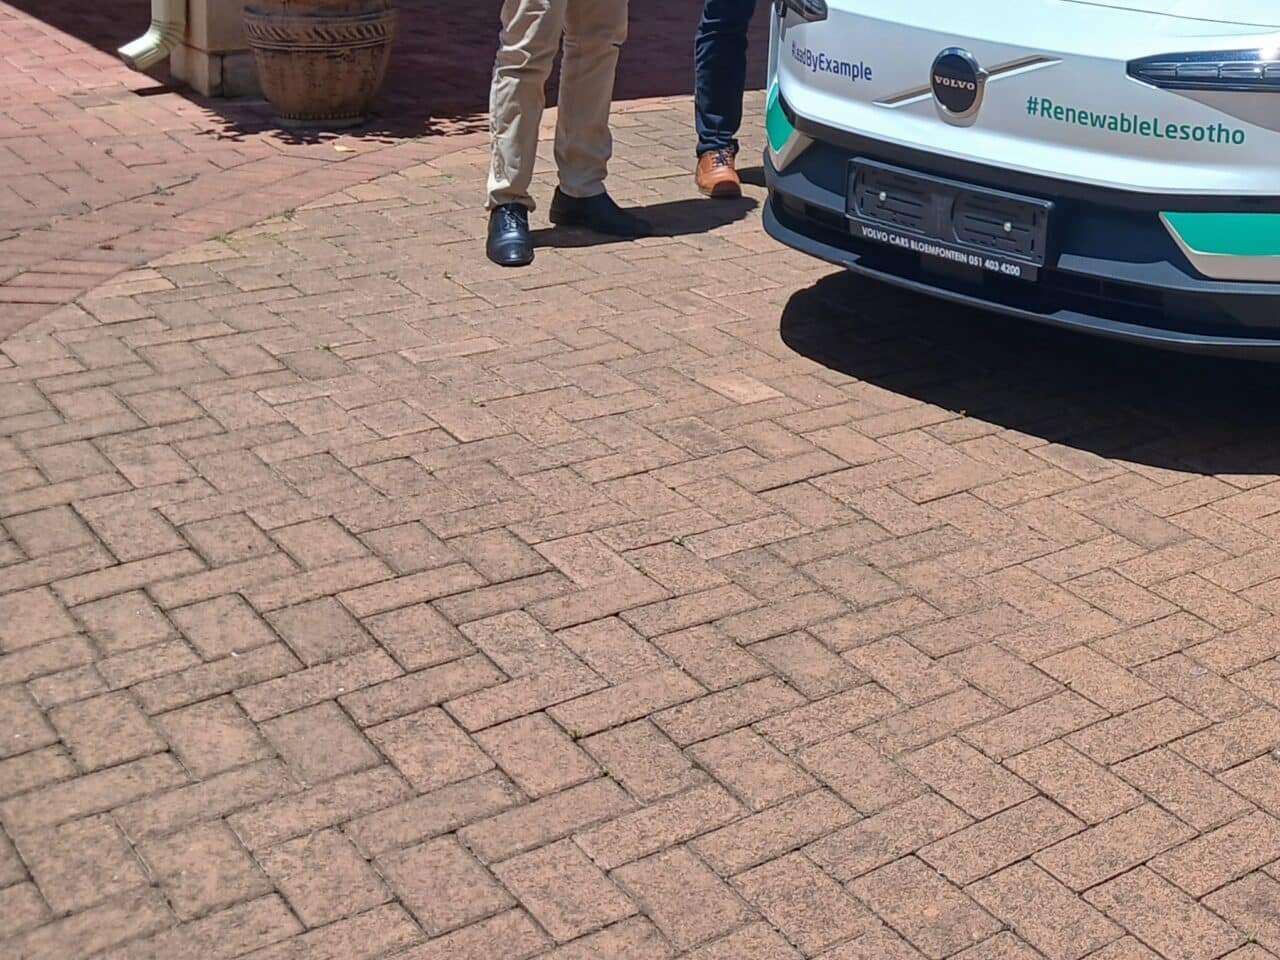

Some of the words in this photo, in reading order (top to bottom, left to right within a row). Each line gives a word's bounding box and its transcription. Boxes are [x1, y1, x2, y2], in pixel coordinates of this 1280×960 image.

[791, 40, 873, 82] #LeadByExample
[934, 74, 976, 91] VOLVO
[1026, 95, 1246, 145] #RenewableLesotho
[861, 226, 888, 242] VOLVO
[888, 234, 910, 249] CARS
[910, 239, 968, 264] BLOEMFONTEIN
[968, 255, 983, 268] 051
[984, 259, 1000, 272] 403
[1000, 263, 1021, 277] 4200
